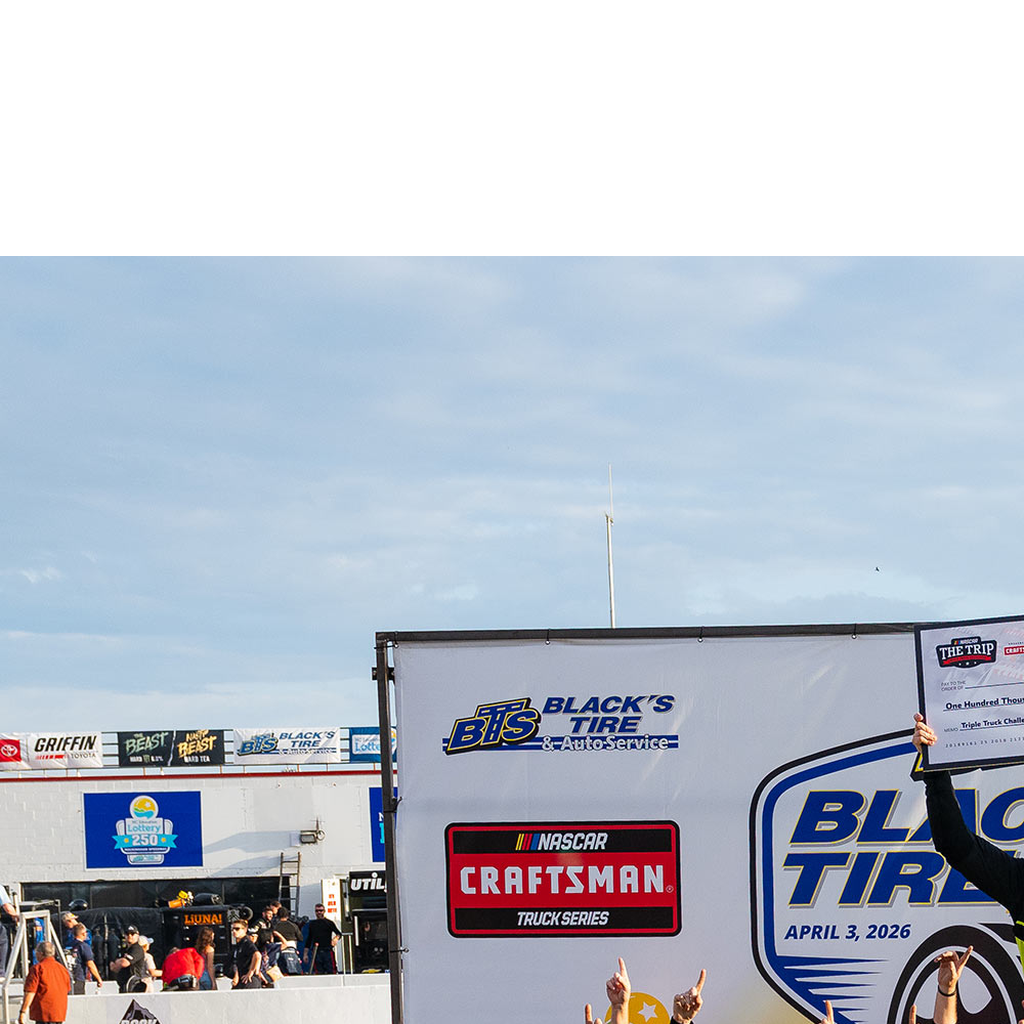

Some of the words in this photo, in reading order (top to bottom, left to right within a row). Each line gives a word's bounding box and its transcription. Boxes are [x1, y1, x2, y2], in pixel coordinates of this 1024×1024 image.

[939, 645, 966, 660] THE
[966, 643, 994, 657] TRIP
[542, 694, 676, 714] BLACK'S
[946, 702, 962, 710] One
[964, 699, 999, 708] Hundred
[447, 698, 541, 754] BTS
[569, 716, 642, 734] TIRE
[961, 721, 981, 730] Triple
[983, 719, 1002, 727] Truck
[35, 735, 97, 752] GRIFFIN
[125, 732, 168, 755] BEAST
[279, 731, 335, 740] BLACK'S
[291, 740, 321, 748] TIRE
[541, 736, 555, 751] &
[178, 736, 217, 757] BEAST
[238, 734, 278, 756] BTS
[128, 824, 161, 834] Lottery
[132, 835, 158, 846] 250
[538, 833, 608, 850] NASCAR
[460, 865, 664, 894] CRAFTSMAN
[517, 912, 560, 926] TRUCK
[561, 911, 609, 925] SERIES
[785, 925, 840, 939] APRIL
[845, 924, 861, 942] 3,
[866, 924, 911, 939] 2026
